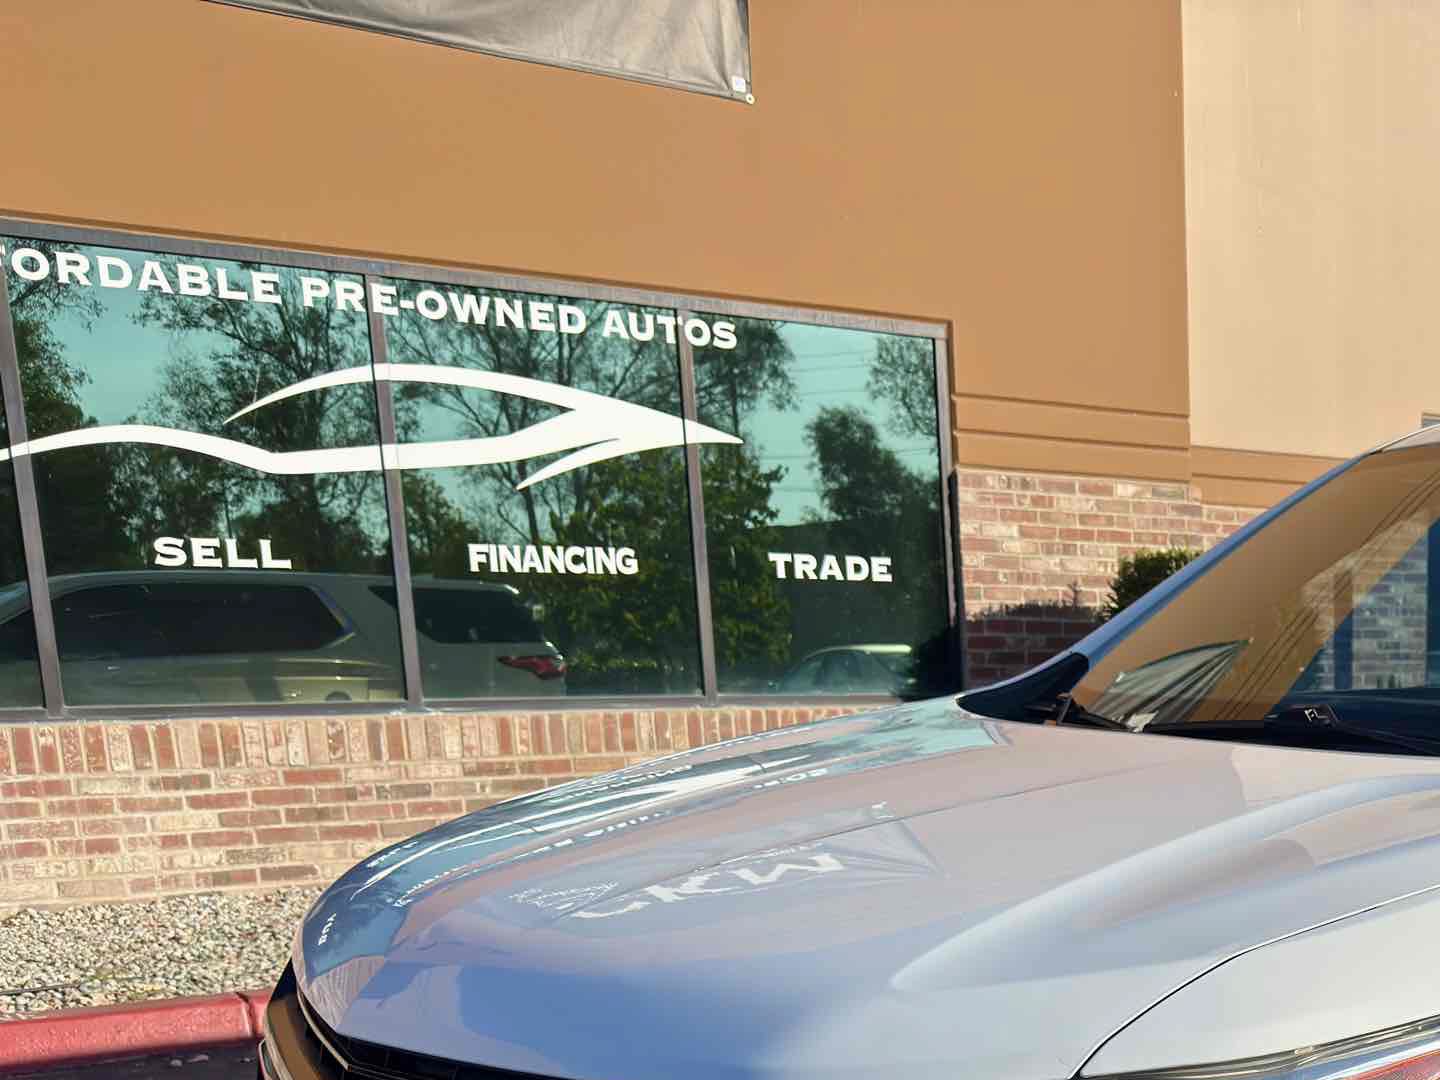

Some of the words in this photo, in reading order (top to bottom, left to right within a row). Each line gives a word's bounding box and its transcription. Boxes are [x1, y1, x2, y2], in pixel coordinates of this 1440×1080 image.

[0, 244, 283, 305] ORDABLE
[300, 275, 587, 335] PRE-OWNED
[602, 309, 738, 350] AUTOS
[153, 536, 292, 569] SELL
[467, 543, 639, 575] FINANCING
[768, 552, 894, 582] TRADE
